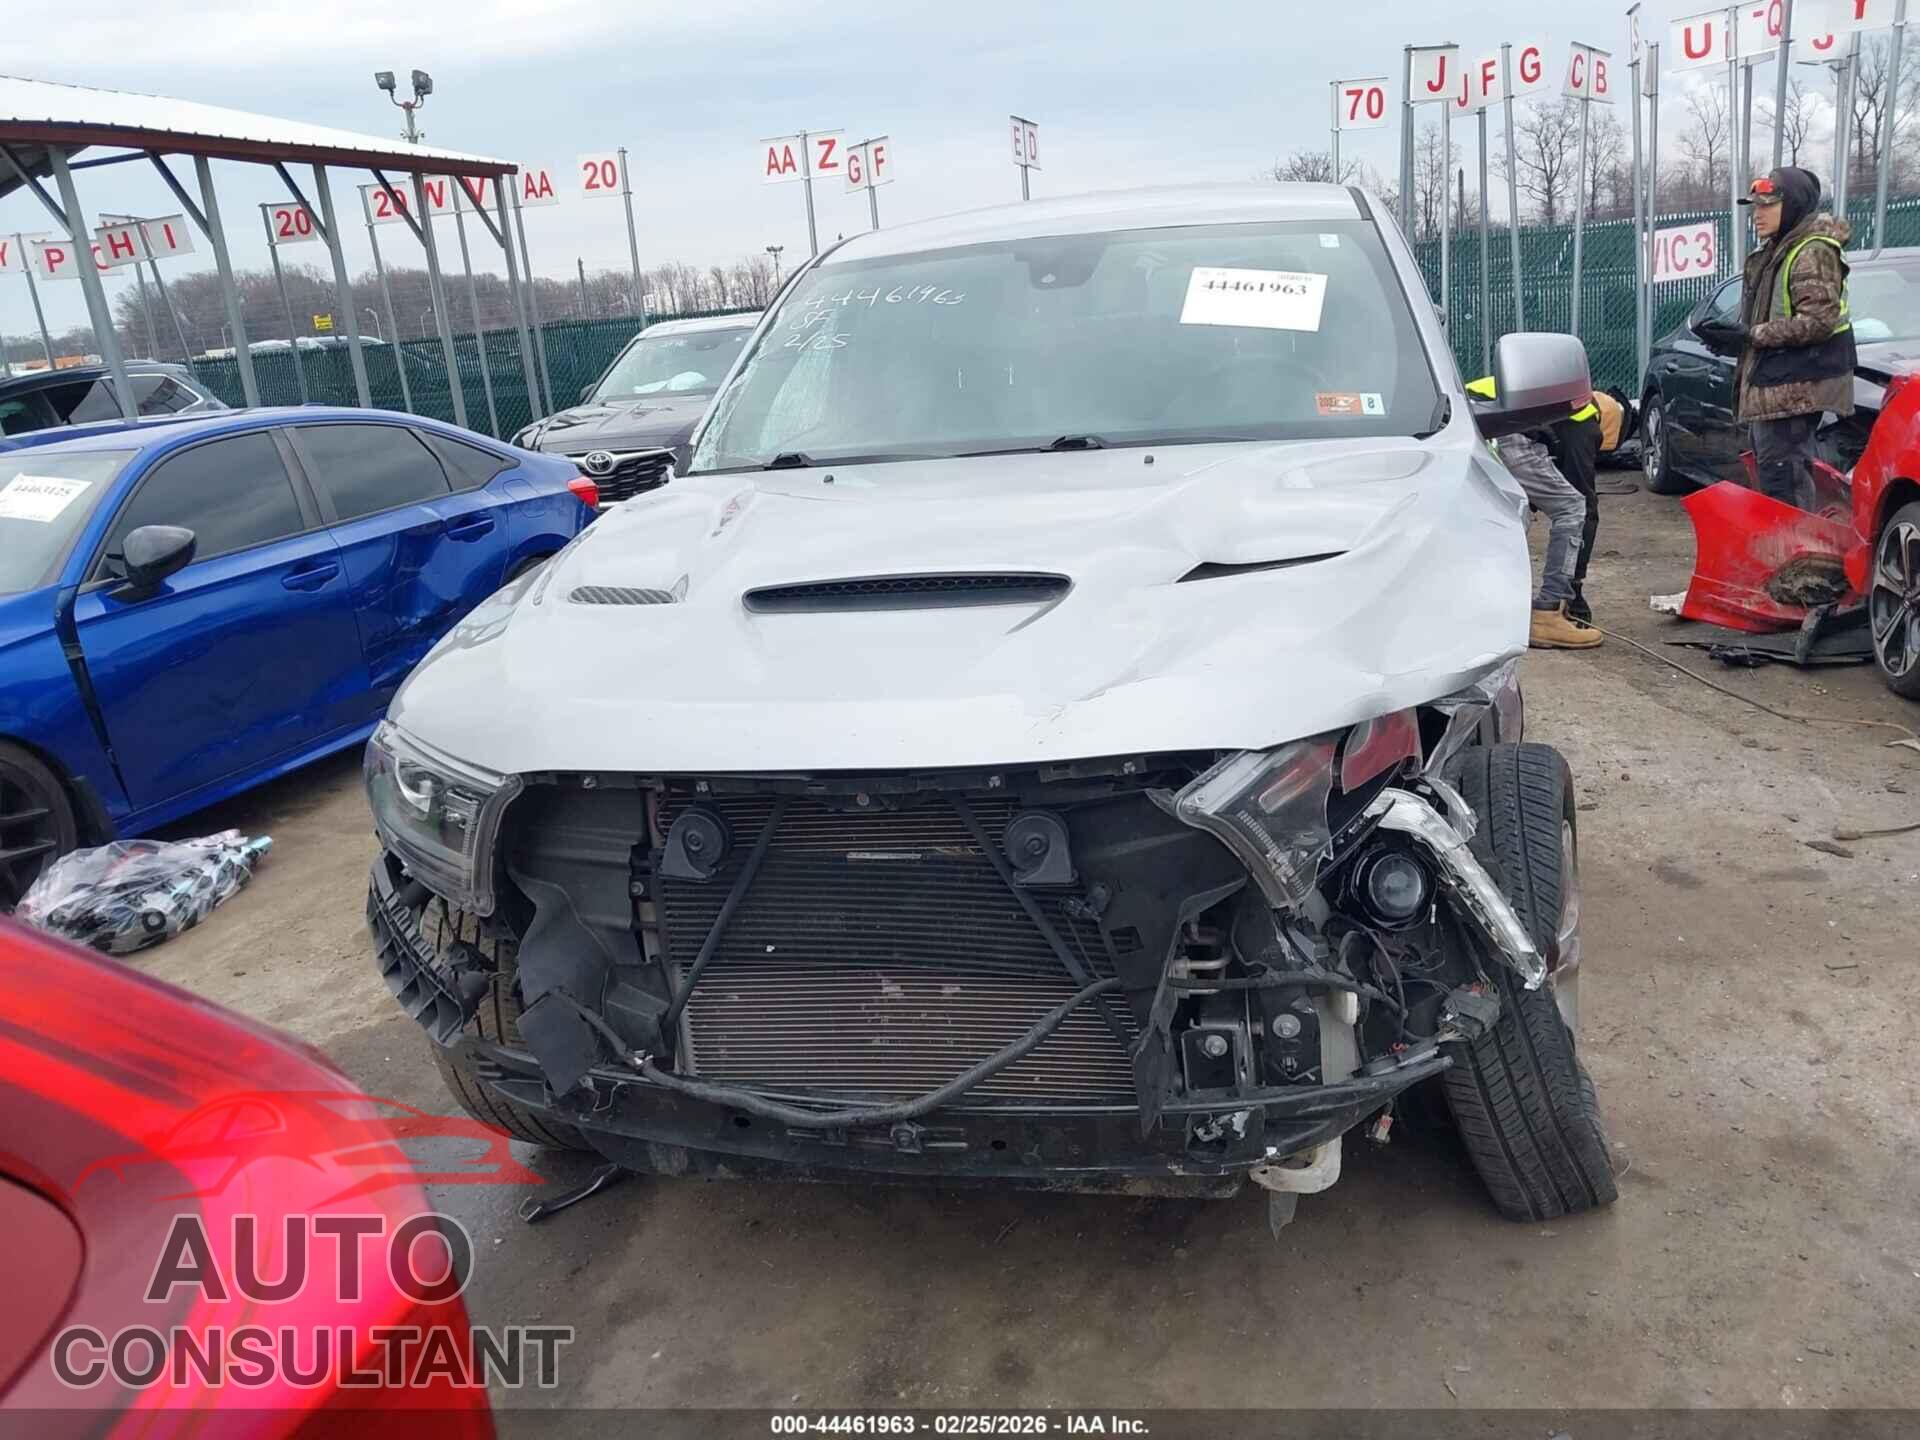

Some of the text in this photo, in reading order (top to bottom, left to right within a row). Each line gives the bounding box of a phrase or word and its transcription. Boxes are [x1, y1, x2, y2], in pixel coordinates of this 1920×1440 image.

[1684, 22, 1712, 60] U
[1426, 55, 1446, 93] J
[1482, 60, 1496, 96] F
[1519, 47, 1541, 84] G
[1570, 53, 1585, 89] C
[1595, 59, 1608, 94] B
[1345, 86, 1385, 121] 70
[817, 138, 839, 170] Z
[1013, 126, 1021, 156] E
[1029, 131, 1037, 160] D
[582, 159, 618, 190] 20
[766, 144, 798, 177] AA
[848, 153, 862, 184] G
[874, 147, 884, 176] F
[523, 170, 554, 200] AA
[373, 189, 408, 219] 20
[275, 209, 311, 236] 20
[44, 247, 66, 274] P
[107, 231, 135, 259] H
[1695, 231, 1715, 269] 3
[806, 284, 968, 309] 44461963
[1202, 280, 1307, 295] 44461963
